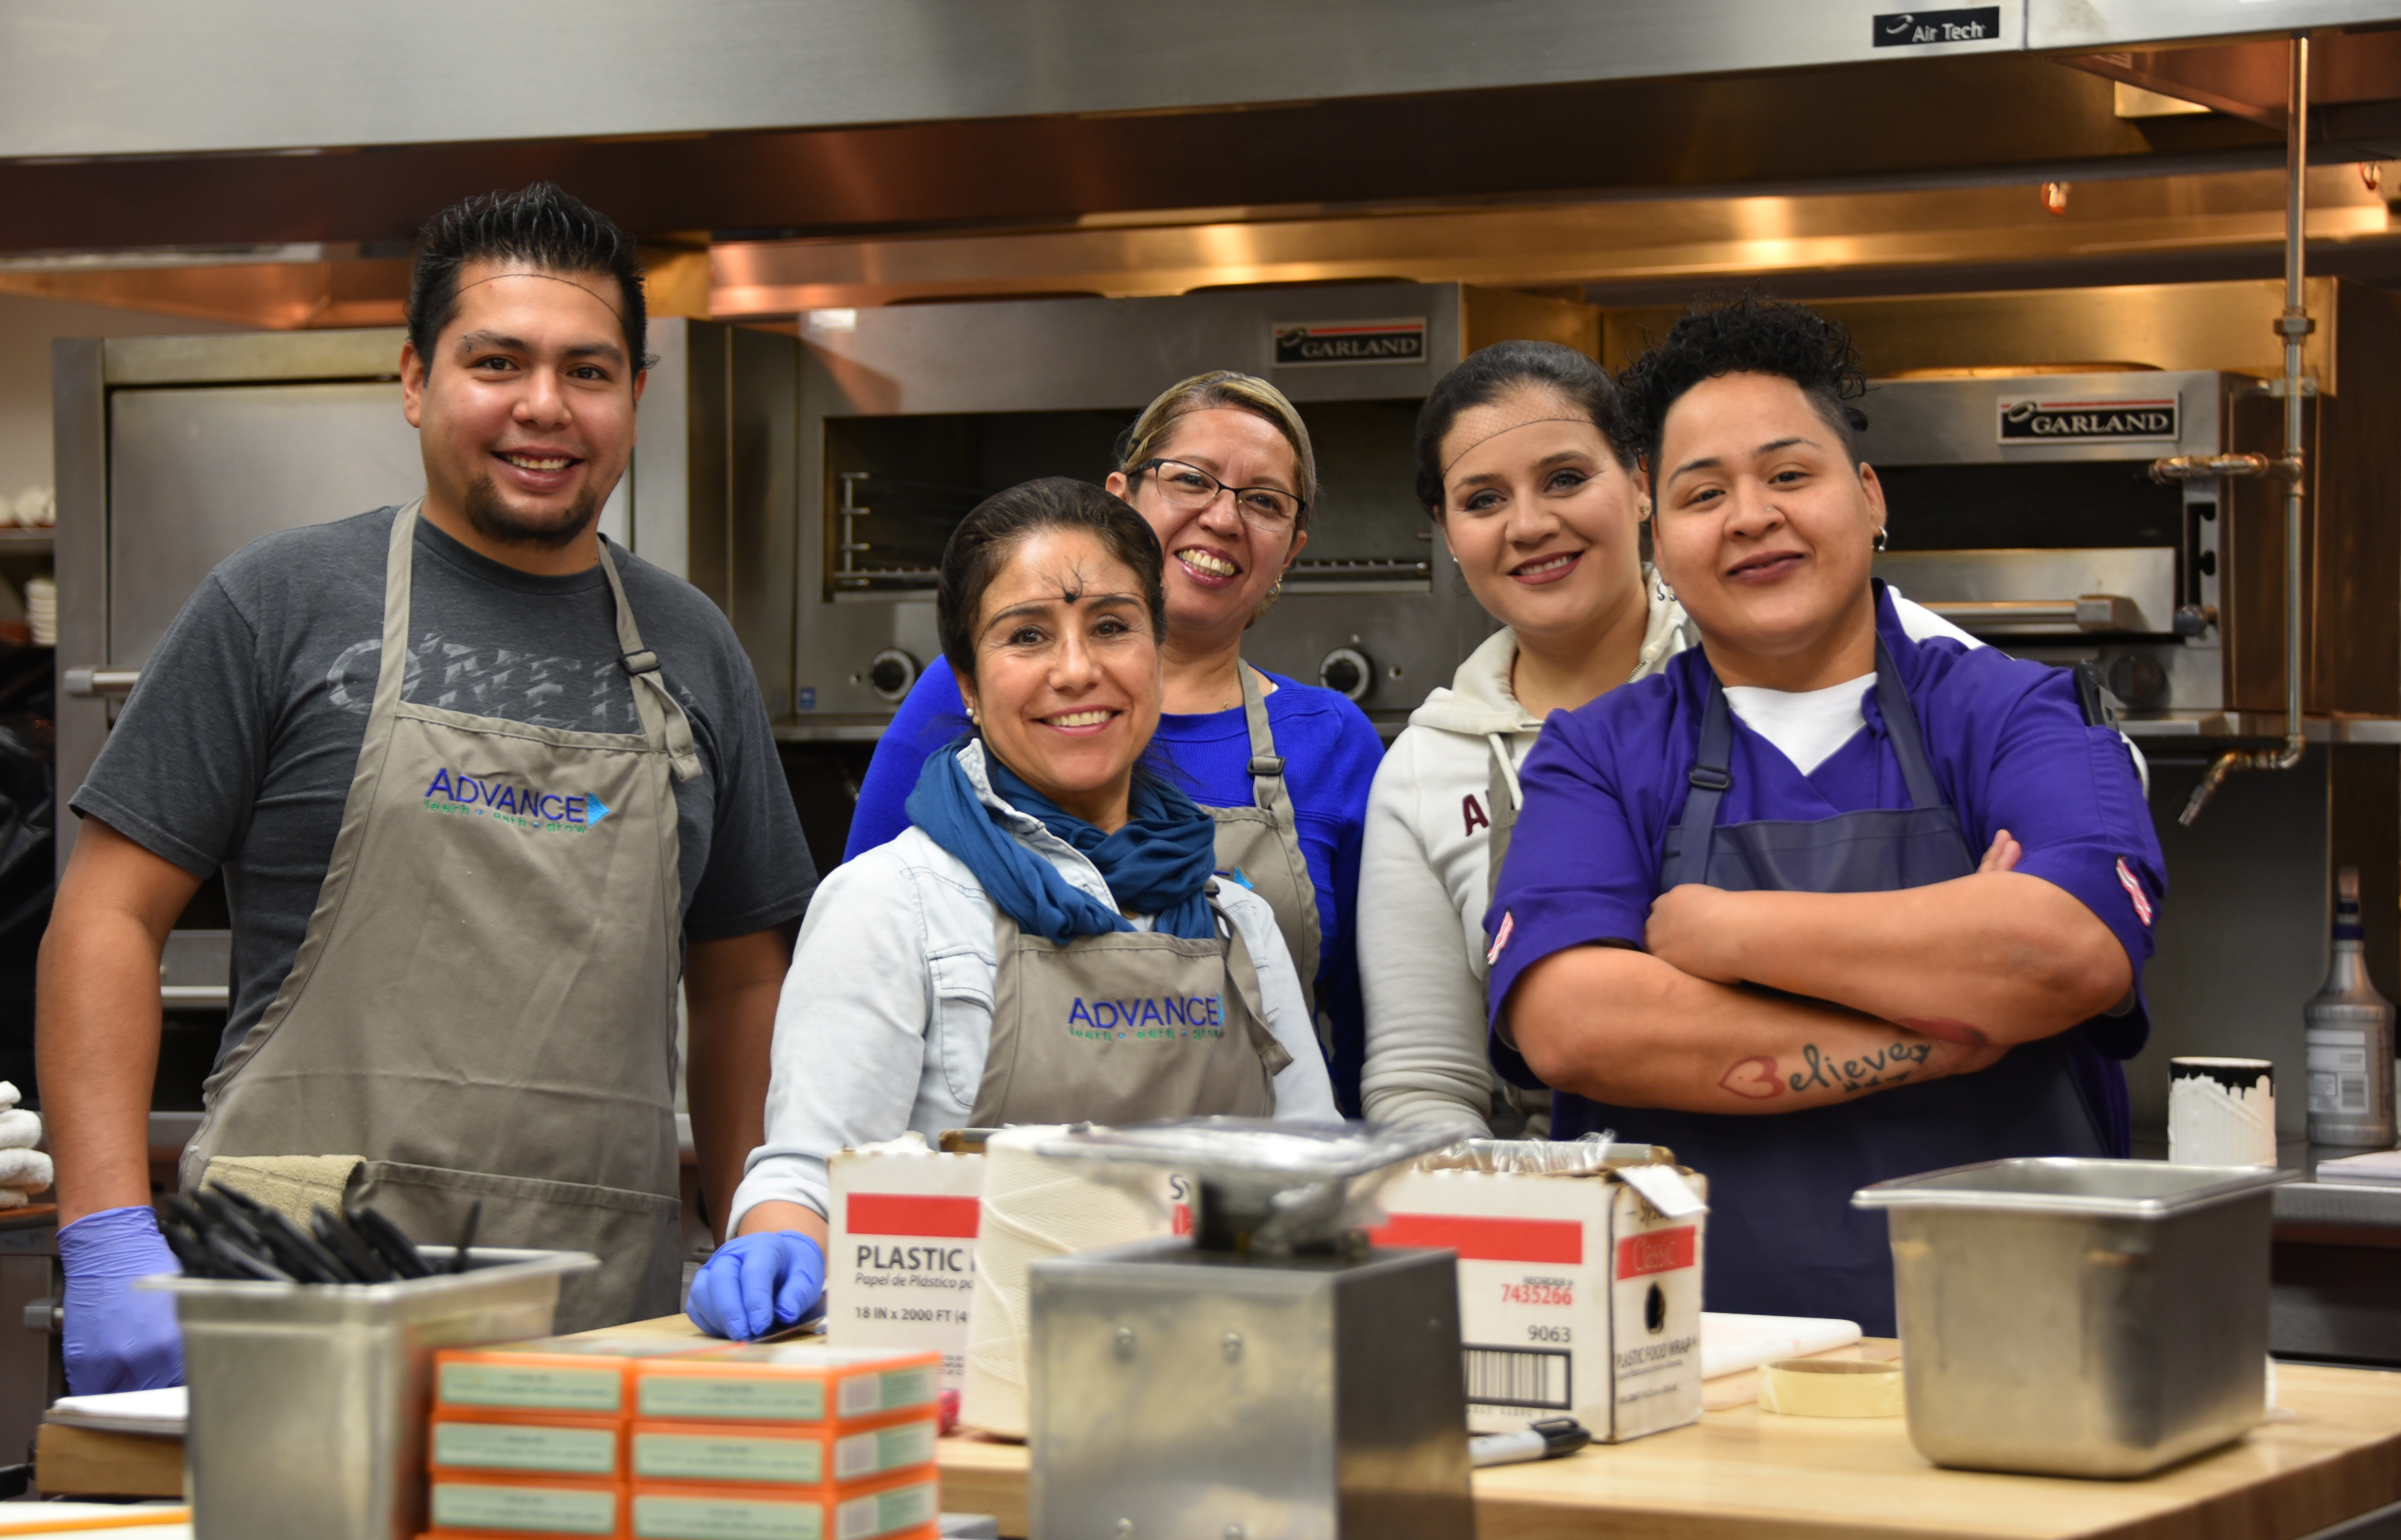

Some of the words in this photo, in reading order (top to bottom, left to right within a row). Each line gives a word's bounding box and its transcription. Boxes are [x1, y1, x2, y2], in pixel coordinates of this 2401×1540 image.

[1911, 25, 1938, 42] Air
[1941, 20, 1984, 40] Tech
[1301, 337, 1418, 359] GARLAND
[2031, 412, 2169, 435] GARLAND
[424, 768, 585, 823] ADVANCE
[424, 799, 470, 815] learn
[493, 812, 526, 827] earn
[546, 821, 586, 834] grow
[1462, 789, 1491, 837] A
[1067, 997, 1219, 1028] ADVANCE
[1068, 1025, 1112, 1041] learn
[1136, 1028, 1175, 1039] earn
[856, 1245, 964, 1272] PLASTIC
[855, 1272, 888, 1288] Papel
[893, 1273, 907, 1286] de
[910, 1274, 957, 1289] Plástico
[1501, 1283, 1573, 1306] 7435266
[855, 1306, 871, 1319] 18
[875, 1307, 888, 1319] IN
[890, 1310, 899, 1319] x
[901, 1308, 933, 1321] 2000
[936, 1309, 951, 1322] FT
[1527, 1325, 1571, 1343] 9063
